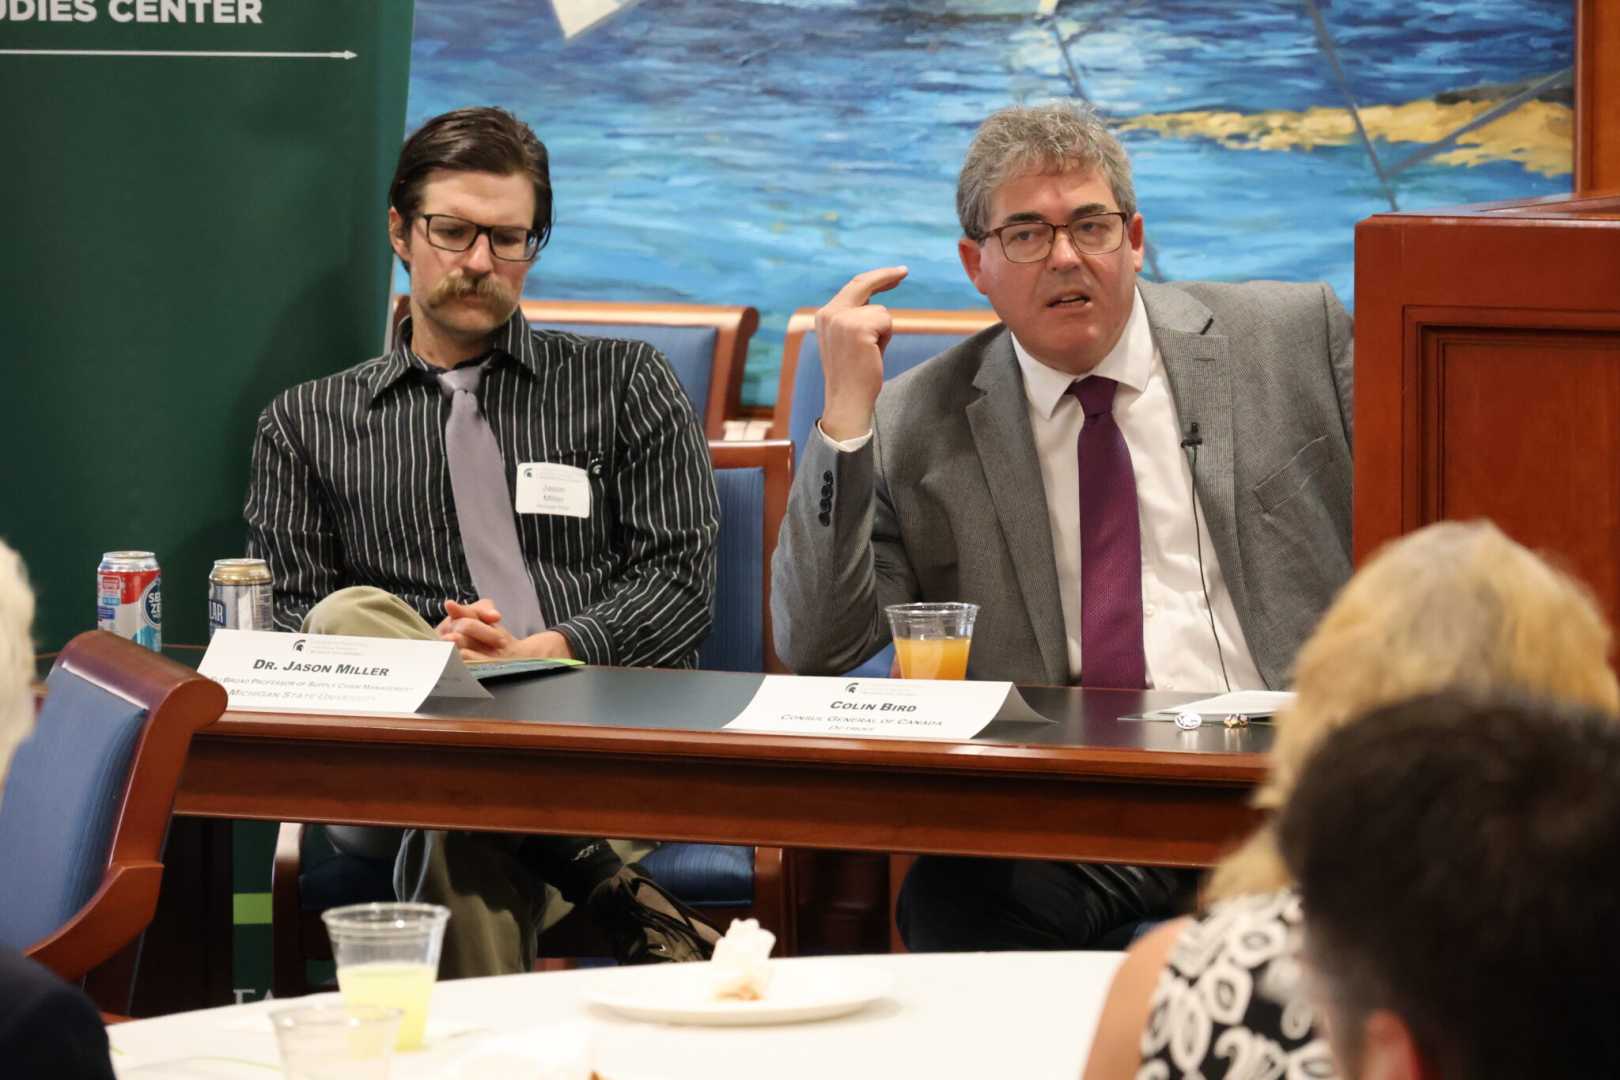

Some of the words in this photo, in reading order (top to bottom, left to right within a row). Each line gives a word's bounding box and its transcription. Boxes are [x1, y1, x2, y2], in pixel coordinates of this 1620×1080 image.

[0, 0, 97, 22] DIES
[108, 0, 263, 24] CENTER
[253, 659, 278, 670] DR.
[283, 661, 333, 673] JASON
[335, 664, 390, 677] MILLER
[830, 700, 877, 711] COLIN
[879, 703, 917, 712] BIRD
[827, 715, 876, 724] GENERAL
